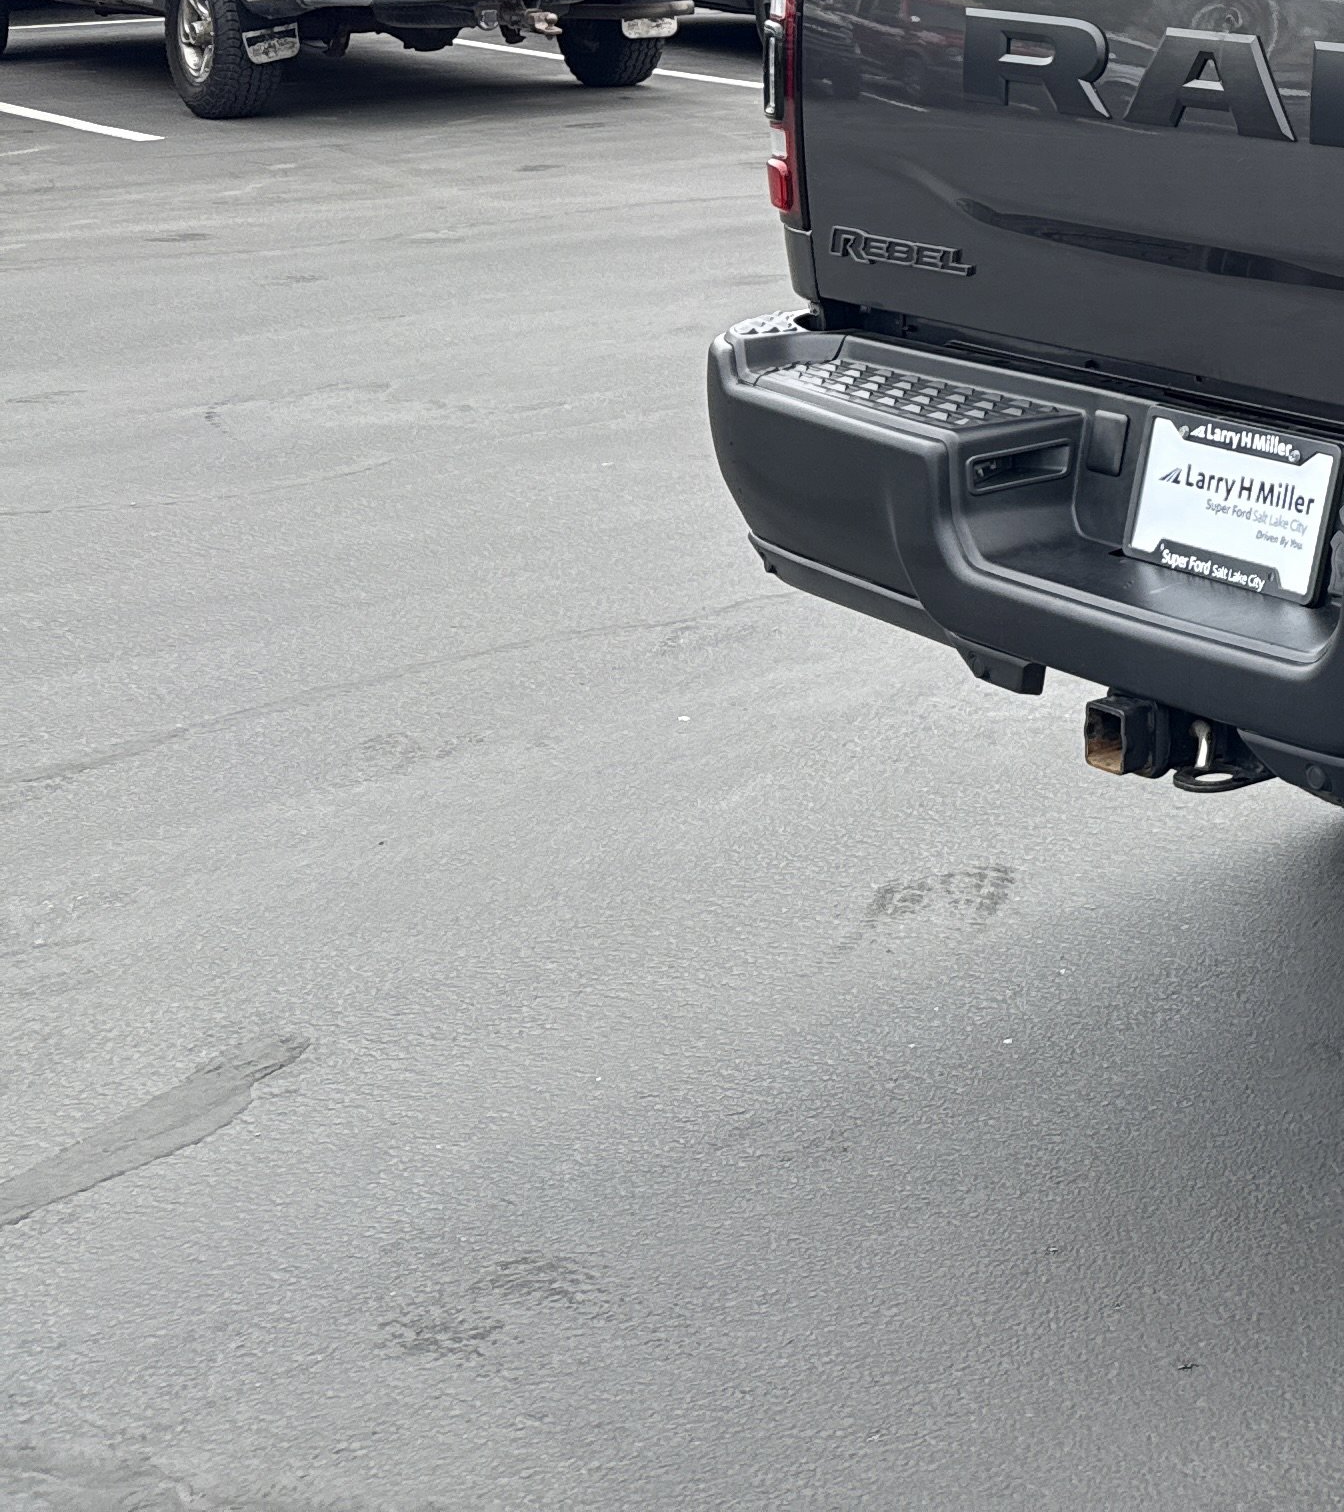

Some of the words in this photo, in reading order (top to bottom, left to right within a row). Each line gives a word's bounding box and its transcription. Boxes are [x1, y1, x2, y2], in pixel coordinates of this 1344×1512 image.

[1206, 423, 1241, 449] Larry
[1241, 431, 1253, 449] H
[1252, 433, 1293, 457] Miller
[1185, 463, 1236, 502] Larry
[1238, 476, 1254, 502] H
[1255, 481, 1315, 516] Miller
[1205, 498, 1231, 516] Super
[1231, 504, 1253, 521] Ford
[1252, 509, 1269, 525] Salt
[1268, 514, 1289, 530] Lake
[1289, 518, 1309, 537] City
[1161, 548, 1189, 569] Super
[1188, 555, 1212, 576] Ford
[1211, 564, 1229, 580] Salt
[1227, 568, 1248, 585] Lake
[1247, 573, 1266, 593] City
